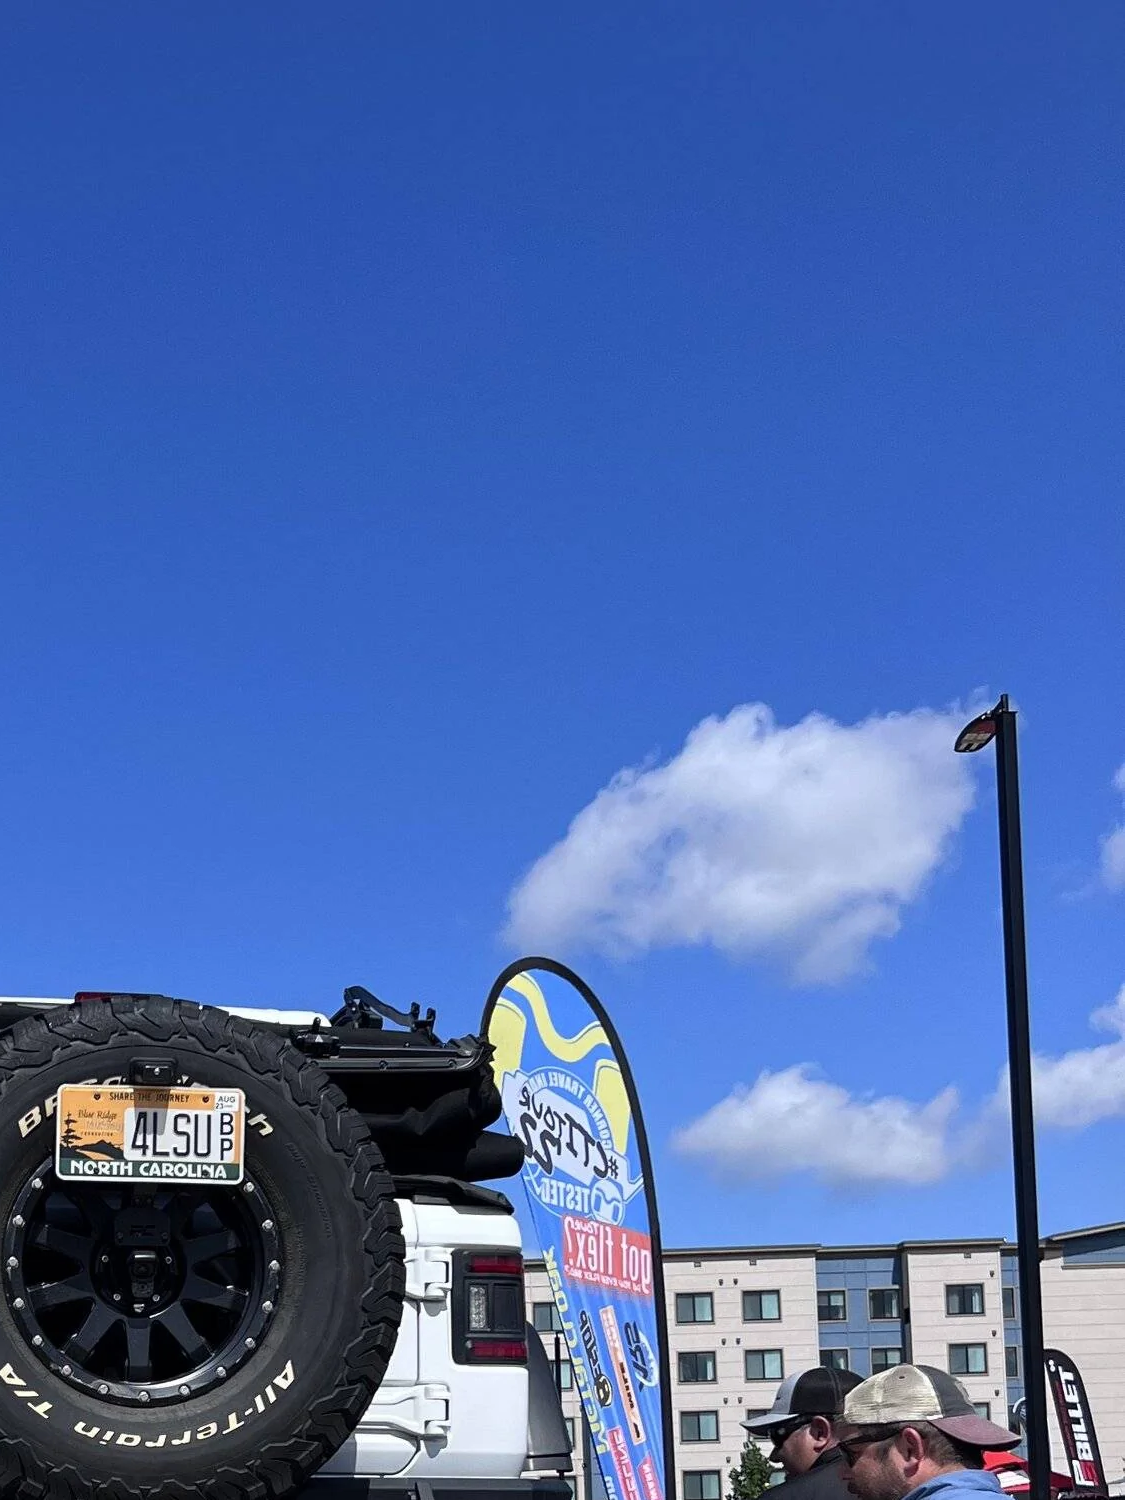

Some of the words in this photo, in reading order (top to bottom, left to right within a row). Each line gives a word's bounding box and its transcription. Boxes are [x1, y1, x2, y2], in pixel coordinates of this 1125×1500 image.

[109, 1091, 134, 1101] SHARE
[137, 1092, 151, 1102] THE
[155, 1093, 190, 1103] JOURNEY
[217, 1095, 236, 1103] AUG
[131, 1110, 211, 1158] 4LSU
[70, 1160, 133, 1176] NORTH
[139, 1162, 227, 1179] CAROLINA
[73, 1359, 296, 1449] All-Terrain
[1058, 1365, 1094, 1461] BILLET
